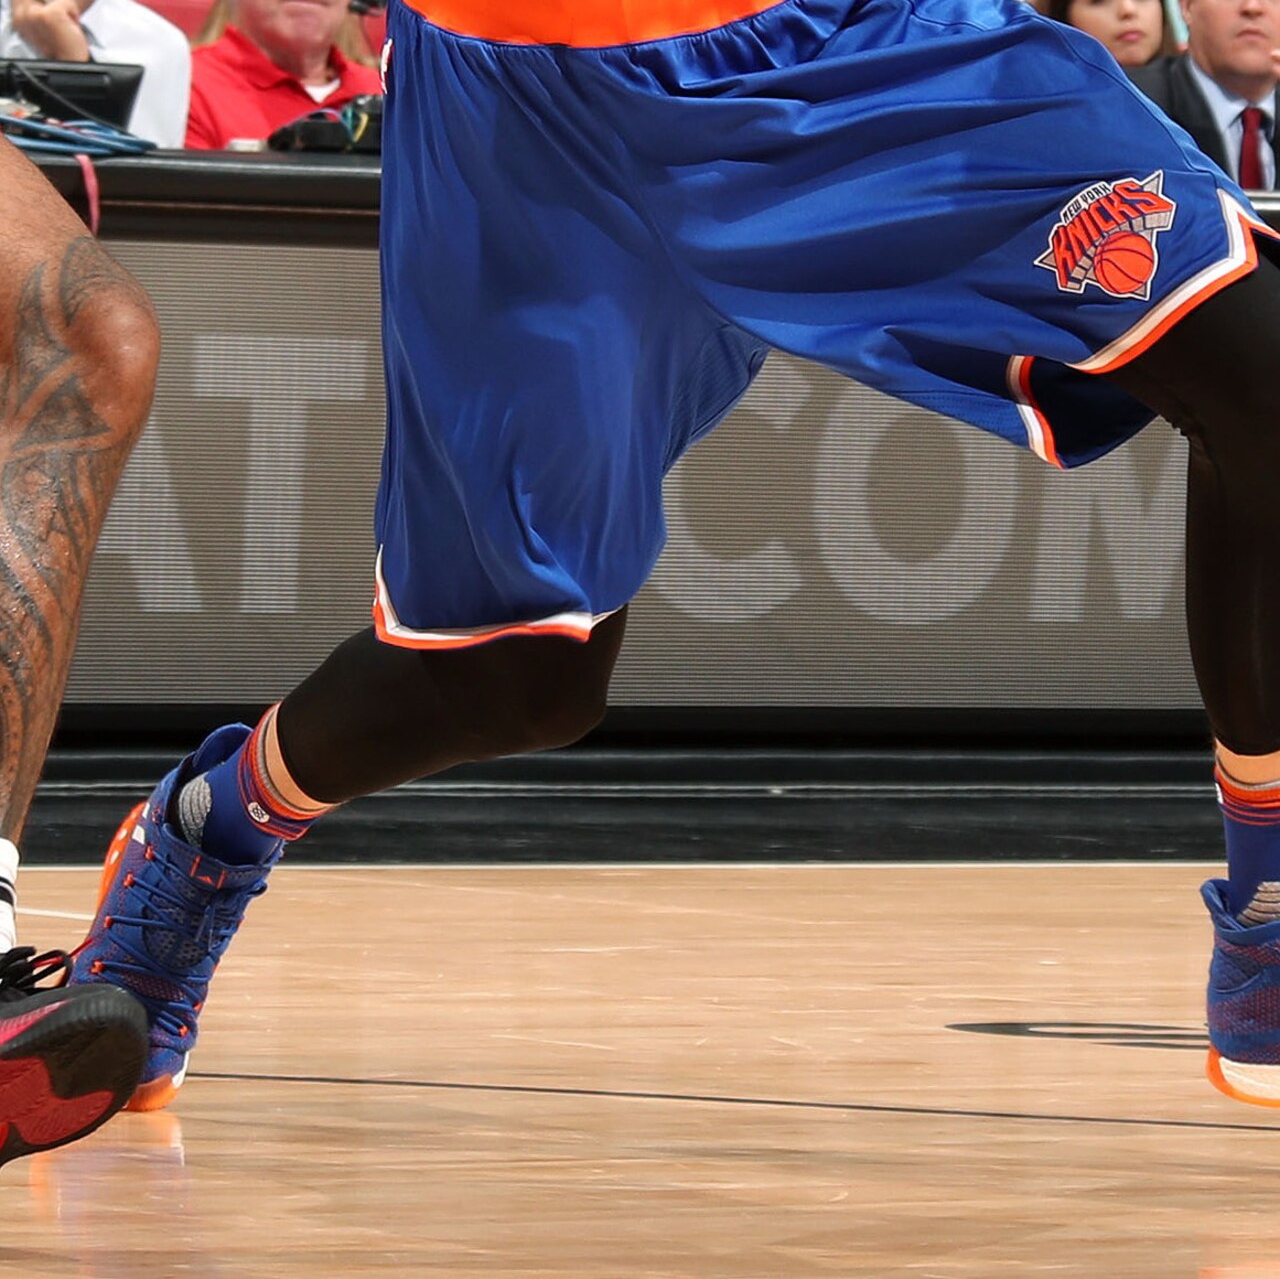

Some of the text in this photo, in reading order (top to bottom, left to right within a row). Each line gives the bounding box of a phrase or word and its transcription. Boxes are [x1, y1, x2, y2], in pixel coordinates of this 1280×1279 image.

[1053, 180, 1174, 288] KNICKS
[1061, 182, 1112, 224] NEW YORK
